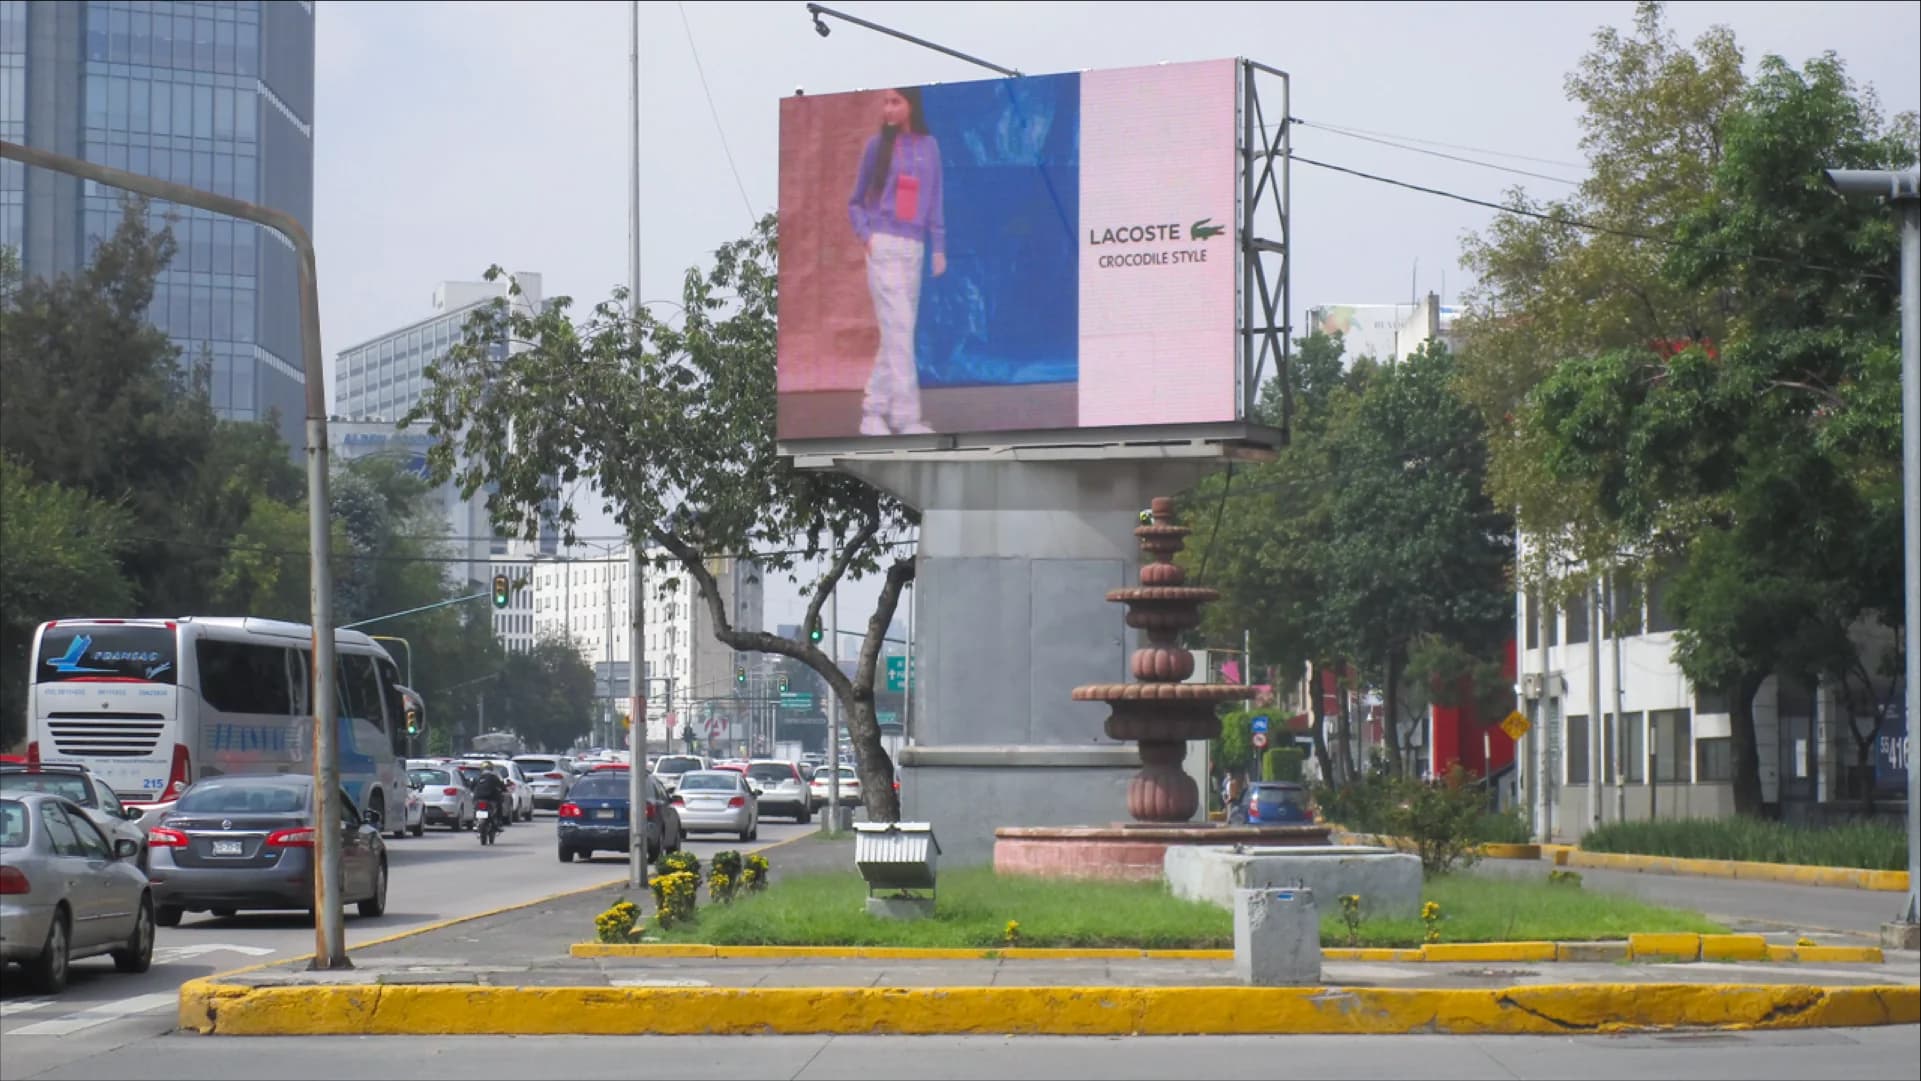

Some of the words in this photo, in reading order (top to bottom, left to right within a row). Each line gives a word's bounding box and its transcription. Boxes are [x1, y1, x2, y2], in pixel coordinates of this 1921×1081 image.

[1090, 224, 1180, 245] LACOSTE
[1099, 251, 1168, 268] CROCODILE
[1172, 249, 1207, 264] STYLE
[143, 779, 164, 789] 215
